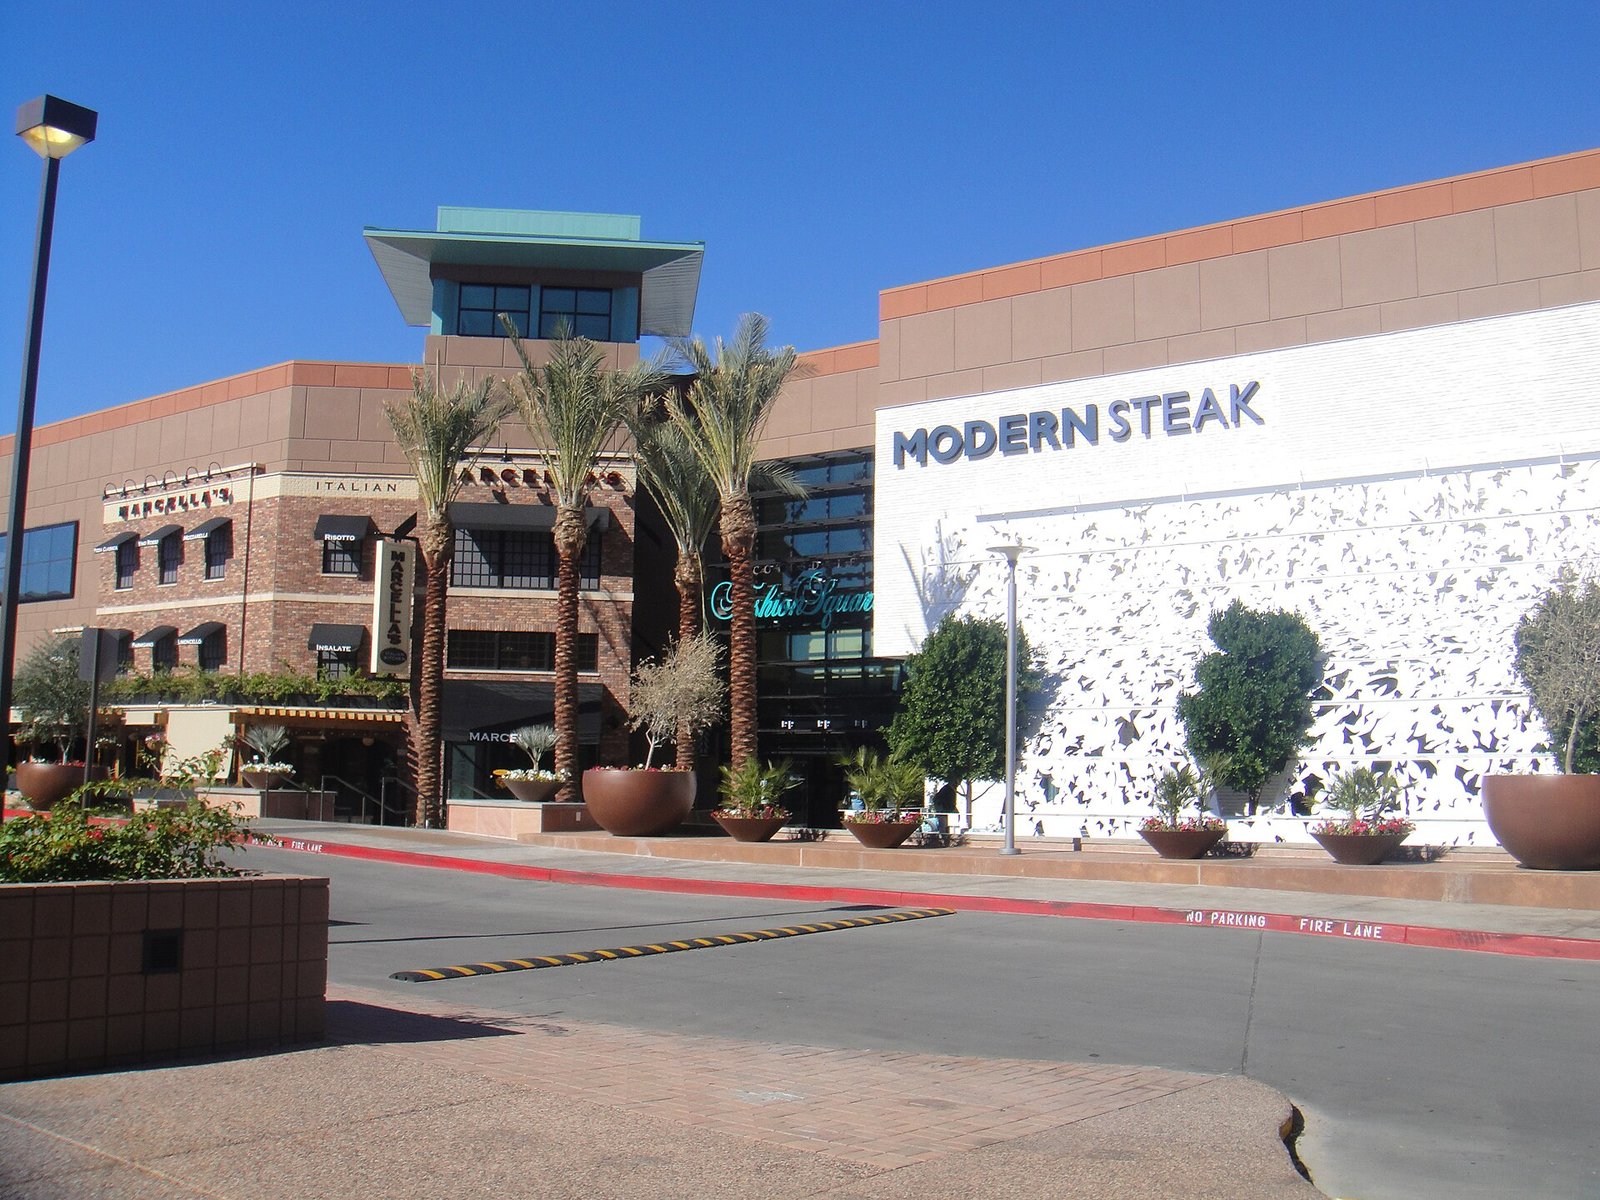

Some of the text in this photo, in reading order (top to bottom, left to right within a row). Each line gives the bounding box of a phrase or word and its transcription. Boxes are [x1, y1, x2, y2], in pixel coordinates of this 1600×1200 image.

[893, 380, 1264, 470] MODERN STEAK
[316, 481, 397, 492] ITALIAN
[119, 487, 229, 518] MARCELLA'S
[324, 533, 355, 541] RISOTTO
[316, 644, 351, 652] INSALATE
[469, 732, 519, 743] MARCE
[1186, 911, 1382, 939] NO PARKING FIRE LANE
